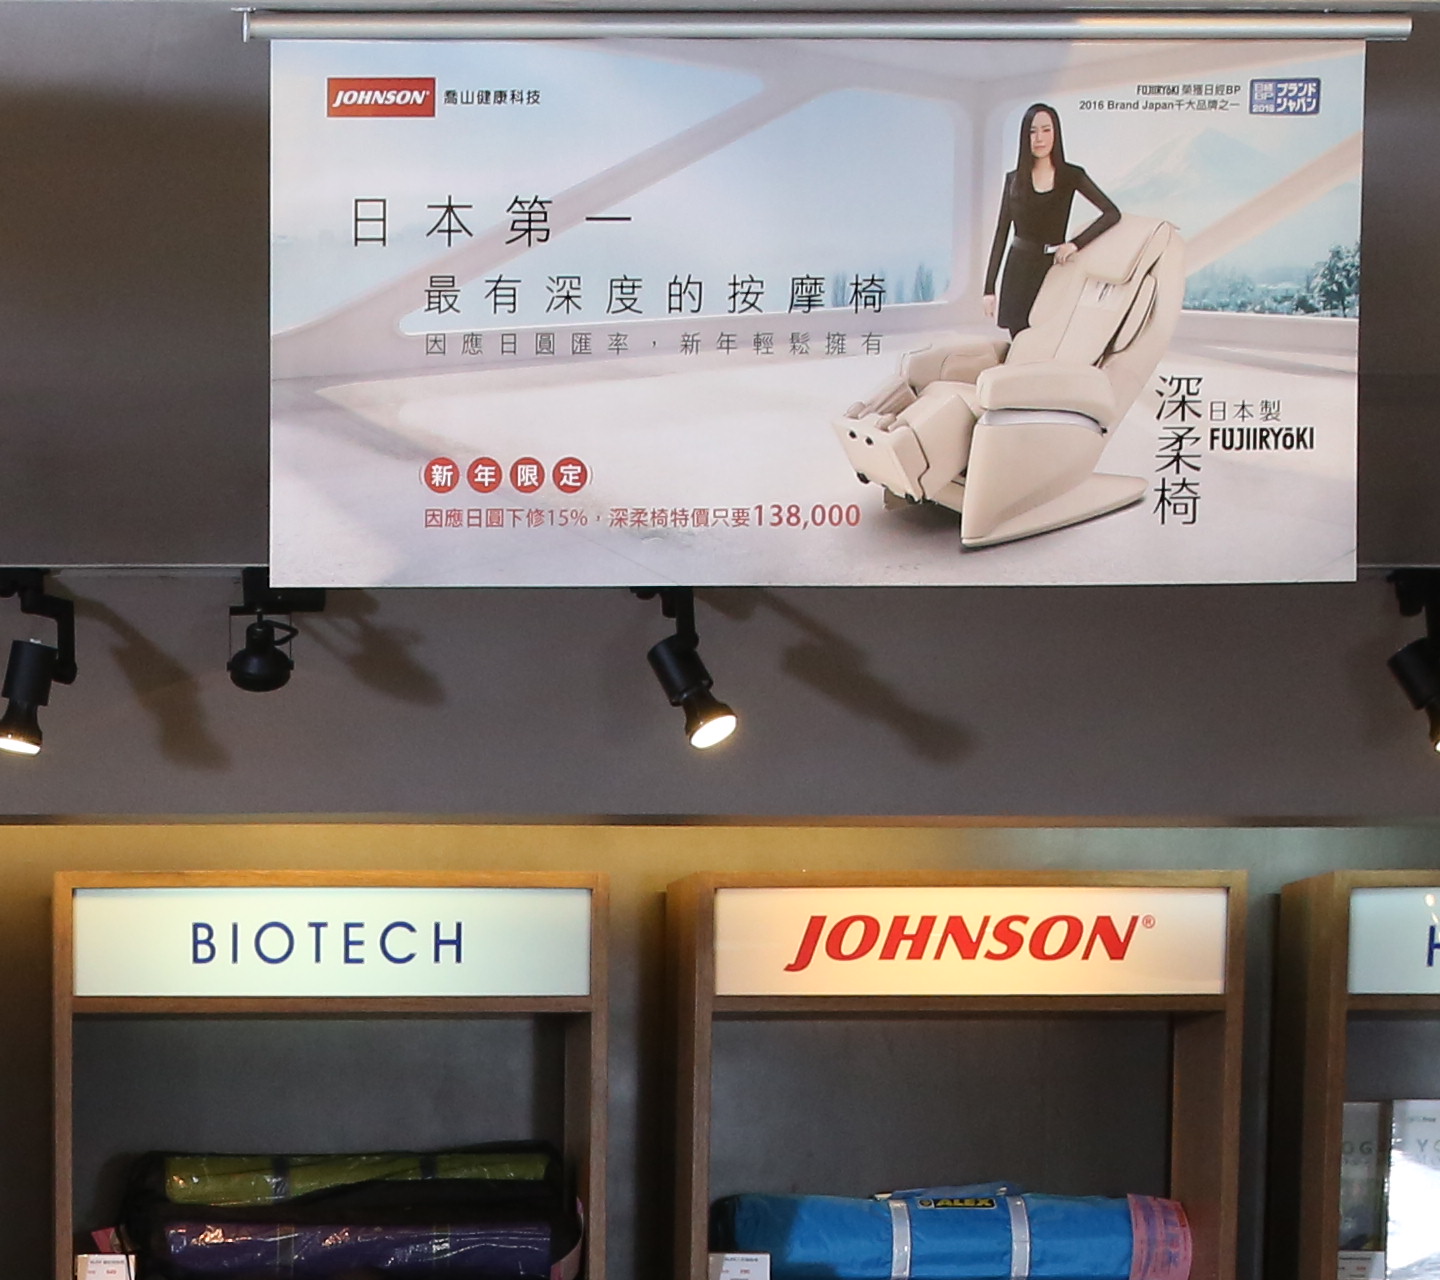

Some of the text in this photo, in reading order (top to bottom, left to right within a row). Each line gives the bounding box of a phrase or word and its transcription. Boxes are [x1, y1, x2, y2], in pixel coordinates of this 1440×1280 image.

[332, 89, 427, 108] JOHNSON
[443, 89, 541, 105] 喬山健康科技
[1277, 82, 1317, 96] ブランド
[1079, 101, 1104, 111] 2016
[1107, 100, 1139, 110] Brand
[1276, 96, 1317, 112] ジャパン
[354, 195, 632, 247] 日本第一
[423, 274, 887, 314] 最有深度的按摩椅
[1210, 400, 1281, 422] 日本製
[1153, 375, 1203, 525] 深柔椅
[428, 461, 584, 489] 新年限定
[192, 921, 466, 965] BIOTECH
[784, 915, 1141, 972] JOHNSON
